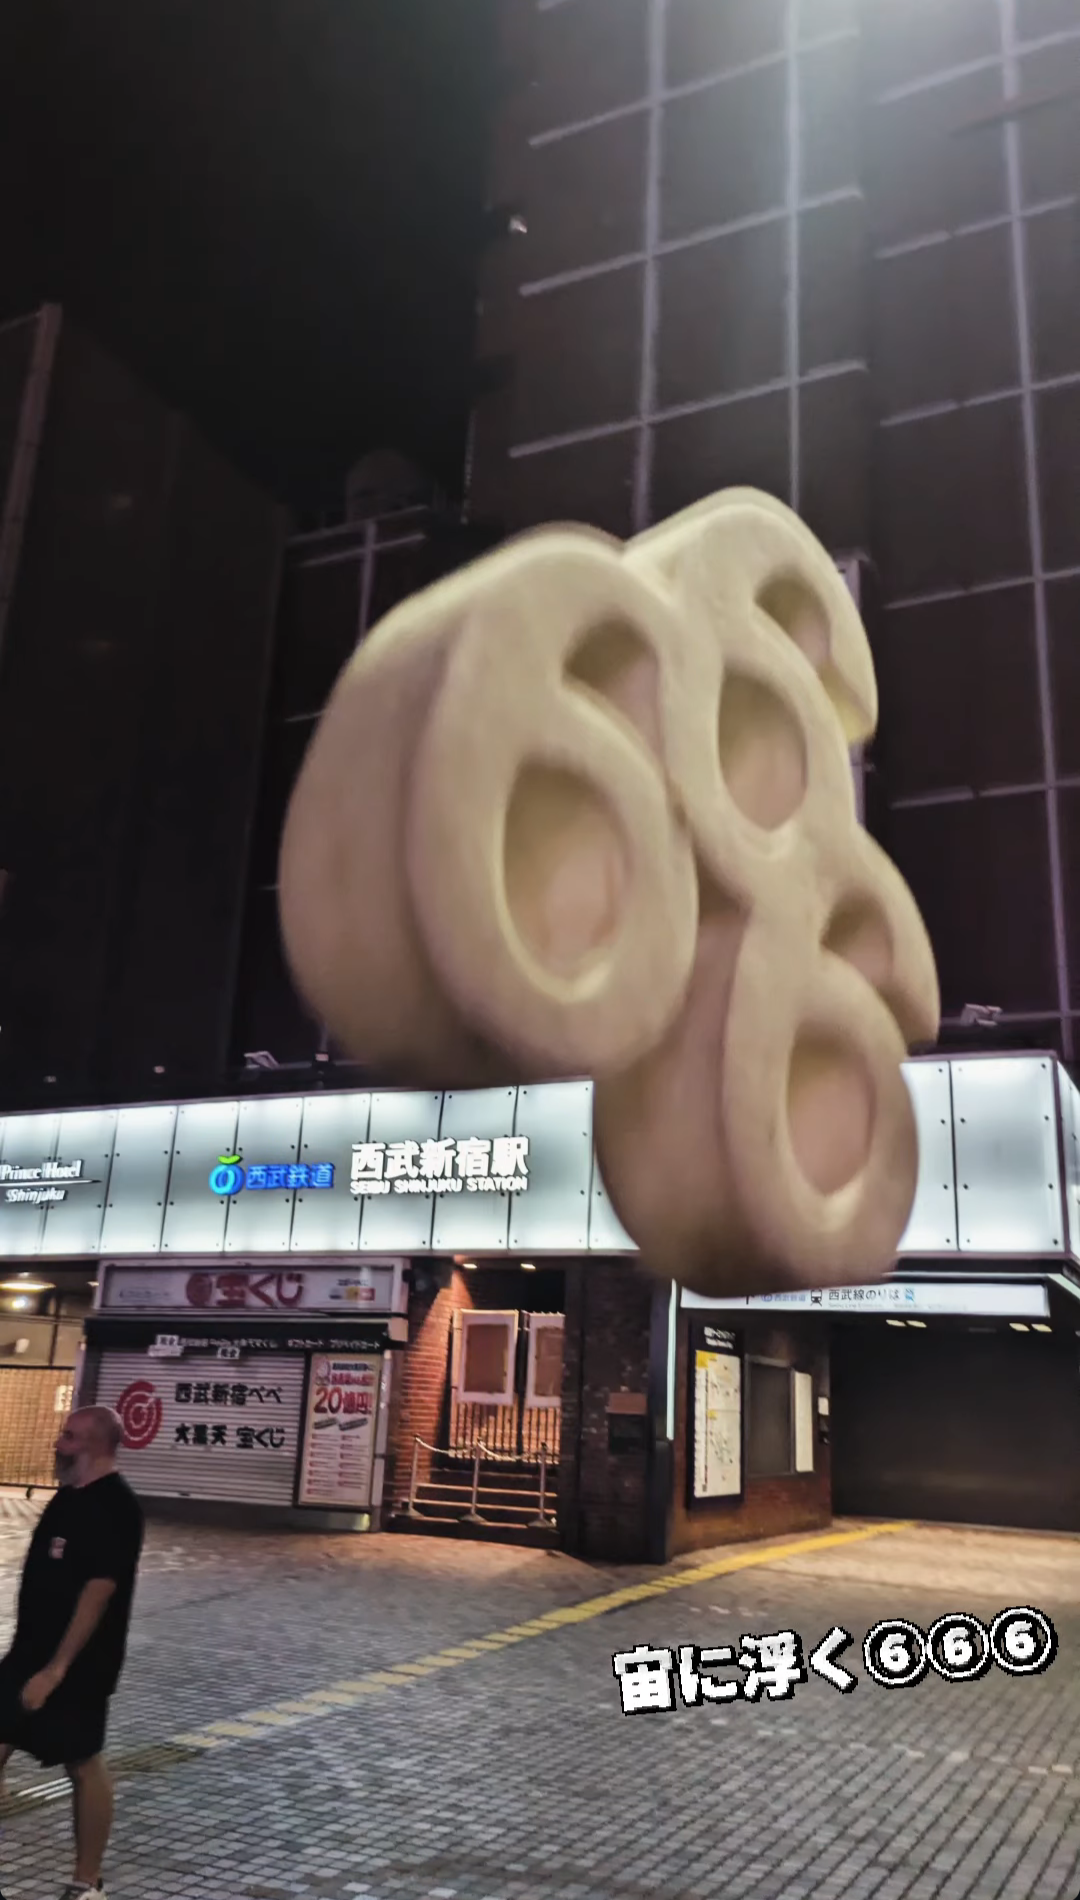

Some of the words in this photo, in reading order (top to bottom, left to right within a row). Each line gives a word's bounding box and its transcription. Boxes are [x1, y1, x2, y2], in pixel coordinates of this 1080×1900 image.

[350, 1136, 529, 1180] 西武新宿駅
[0, 1164, 42, 1180] Prince
[41, 1159, 82, 1178] Hotel
[245, 1162, 334, 1190] 西武鉄道
[5, 1187, 66, 1204] Shinjuku
[350, 1180, 390, 1194] SEIBU
[394, 1177, 462, 1194] SHINJUKU
[466, 1175, 528, 1192] STATION
[236, 1426, 286, 1449] 宝くじ
